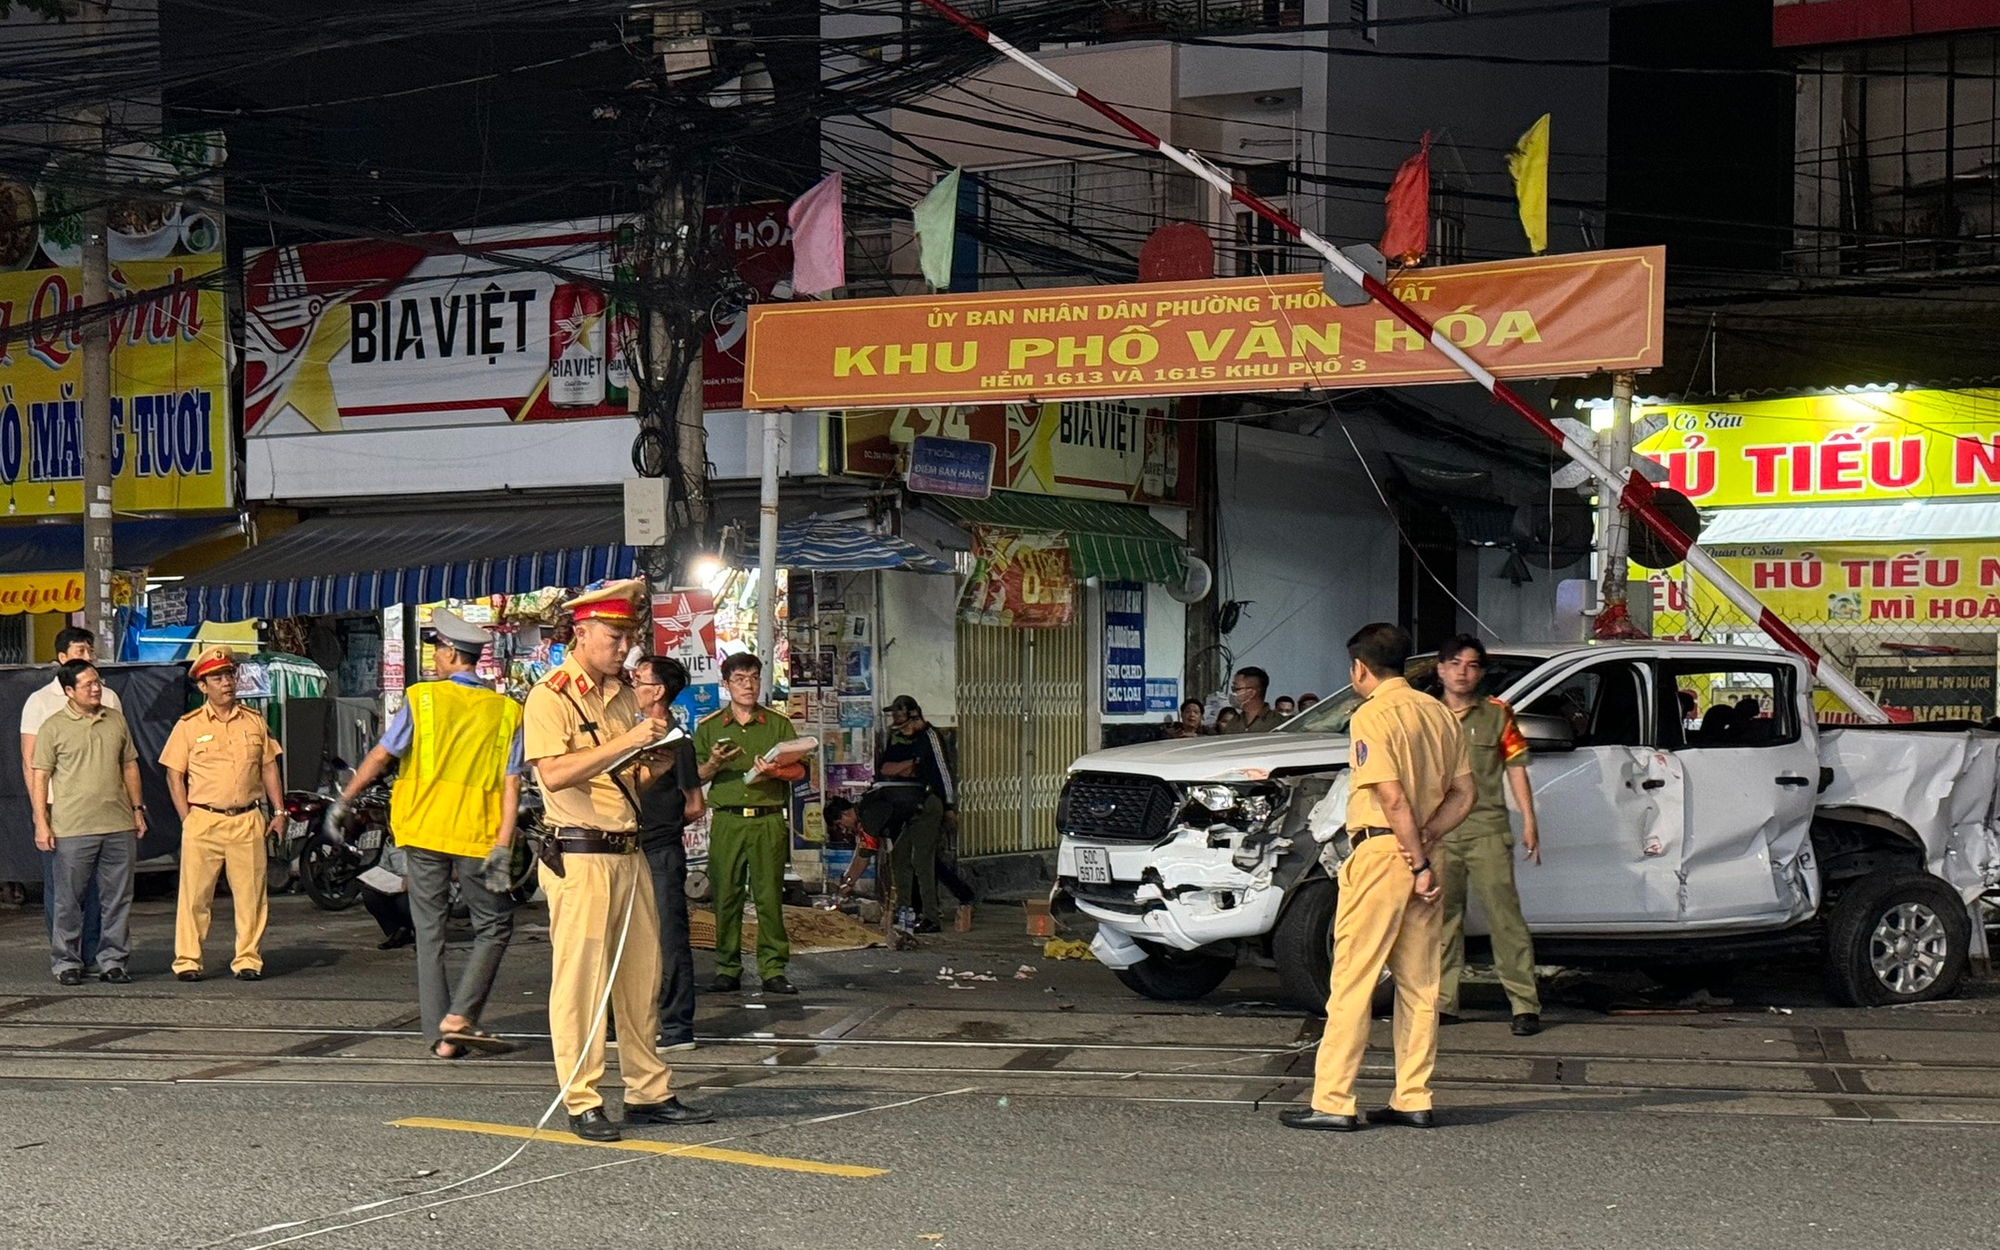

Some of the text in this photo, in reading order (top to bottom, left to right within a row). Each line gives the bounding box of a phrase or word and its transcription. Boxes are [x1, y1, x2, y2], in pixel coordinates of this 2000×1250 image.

[927, 306, 958, 328] ỦY
[966, 309, 1015, 326] BAN
[1023, 302, 1088, 324] NHÂN
[1097, 299, 1147, 320] DÂN
[1156, 294, 1260, 317] PHƯỜNG
[1269, 286, 1338, 310] THỐN
[834, 305, 1543, 377] KHU PHỐ VĂN HÓA
[980, 355, 1367, 388] HẺM 1613 VÀ 1615 KHU PHỐ 3
[30, 382, 125, 482] MĂG
[131, 388, 212, 477] TƯƠI
[1674, 411, 1744, 430] Cô Sáu
[1745, 426, 1921, 494] TIẾU
[1754, 552, 1822, 589] HỦ
[1841, 550, 1960, 587] TIẾU
[1870, 595, 1915, 619] MÌ
[1120, 664, 1143, 679] CARD
[1887, 676, 1898, 689] TY
[1900, 676, 1924, 689] TNHH
[1082, 849, 1098, 865] 60C
